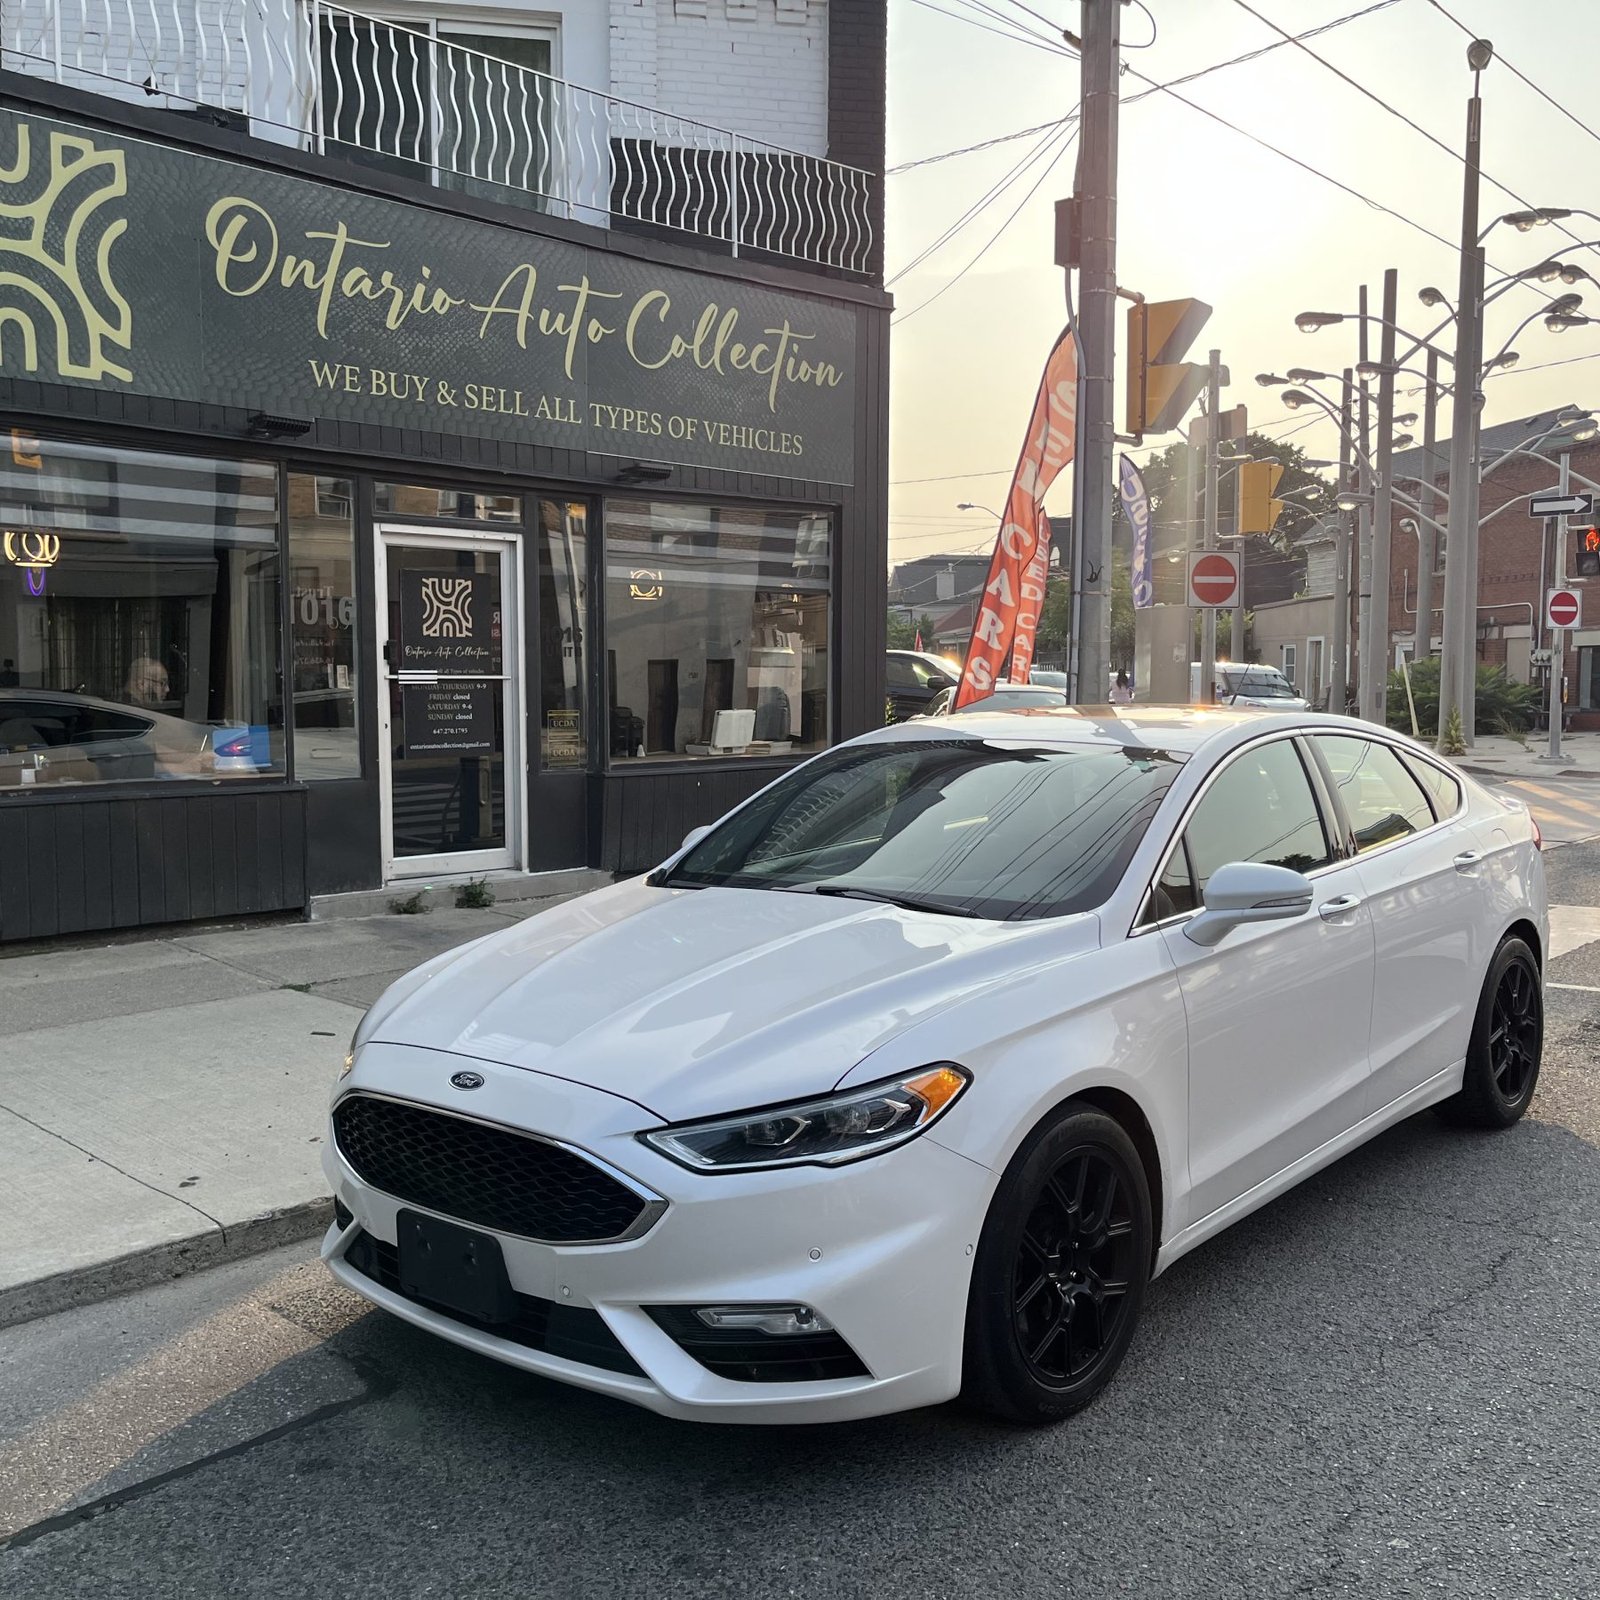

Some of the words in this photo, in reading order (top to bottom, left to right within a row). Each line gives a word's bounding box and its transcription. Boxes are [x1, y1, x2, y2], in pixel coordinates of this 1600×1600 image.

[205, 196, 465, 340] Ontario
[469, 263, 623, 381] Auto
[626, 290, 844, 414] Collection
[308, 359, 362, 393] WE
[369, 369, 430, 402] BUY
[437, 380, 458, 407] &
[464, 383, 529, 417] SELL
[534, 395, 582, 424] ALL
[589, 403, 662, 436] TYPES
[668, 416, 698, 440] OF
[703, 420, 803, 455] VEHICLES
[1016, 347, 1079, 501] SE
[290, 595, 357, 625] 1016
[405, 645, 432, 659] Ontario
[434, 646, 453, 659] Auto
[455, 645, 489, 659] Collection
[966, 523, 1033, 691] CARS
